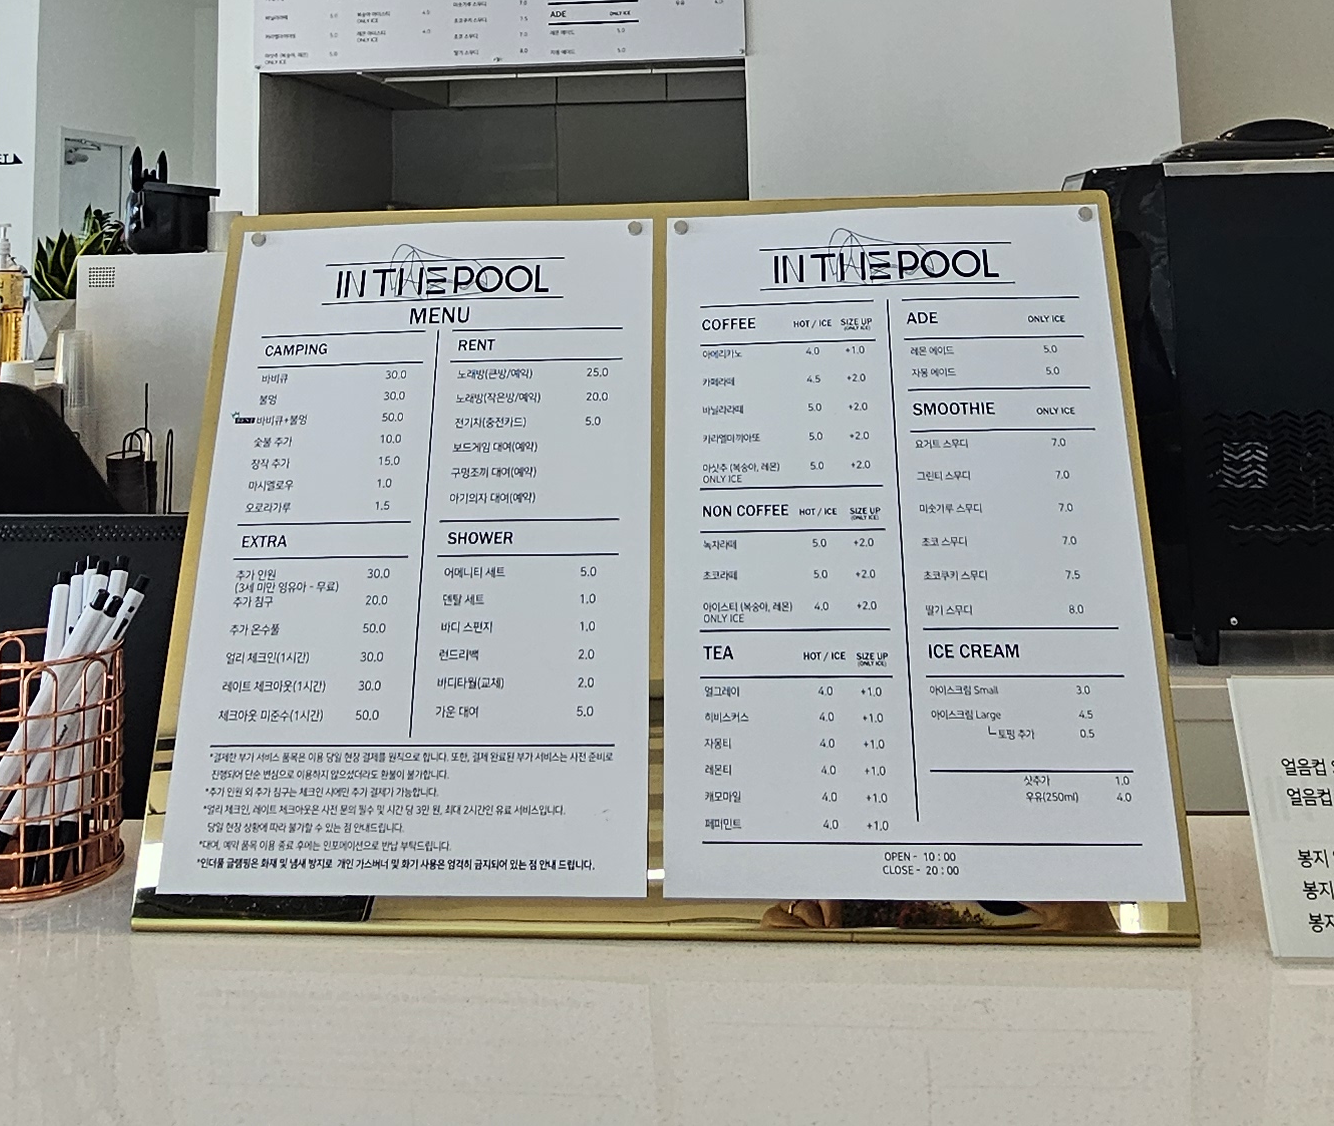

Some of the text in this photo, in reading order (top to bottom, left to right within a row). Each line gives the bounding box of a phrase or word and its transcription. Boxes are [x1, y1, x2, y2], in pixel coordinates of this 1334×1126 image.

[410, 306, 469, 324] MENU
[907, 312, 938, 324] ADE
[702, 318, 755, 330] COFFEE
[265, 343, 327, 356] CAMPING
[458, 339, 495, 351] RENT
[262, 370, 406, 384] 바비큐 30.0
[260, 391, 405, 405] 불멍 30.0
[913, 402, 995, 416] SMOOTHIE
[586, 416, 601, 426] 5.0
[378, 478, 392, 488] 1.0
[703, 504, 788, 517] NON COFFEE
[242, 535, 287, 548] EXTRA
[448, 532, 513, 544] SHOWER
[485, 567, 505, 578] 세트
[581, 567, 596, 576] 5.0
[233, 597, 251, 607] 추가
[366, 595, 387, 605] 20.0
[441, 622, 460, 633] 바디
[581, 621, 595, 631] 1.0
[703, 646, 733, 660] TEA
[929, 644, 1019, 658] ICE CREAM
[818, 686, 833, 696] 4.0
[930, 685, 1090, 695] 아이스크림 Small 3.0
[931, 710, 1093, 721] 아이스크림 Large 4.5
[1281, 758, 1327, 776] 얼음컵
[1117, 793, 1131, 802] 4.0
[1287, 788, 1332, 806] 얼음컵
[1298, 849, 1329, 868] 봉지
[1303, 881, 1334, 900] 봉지
